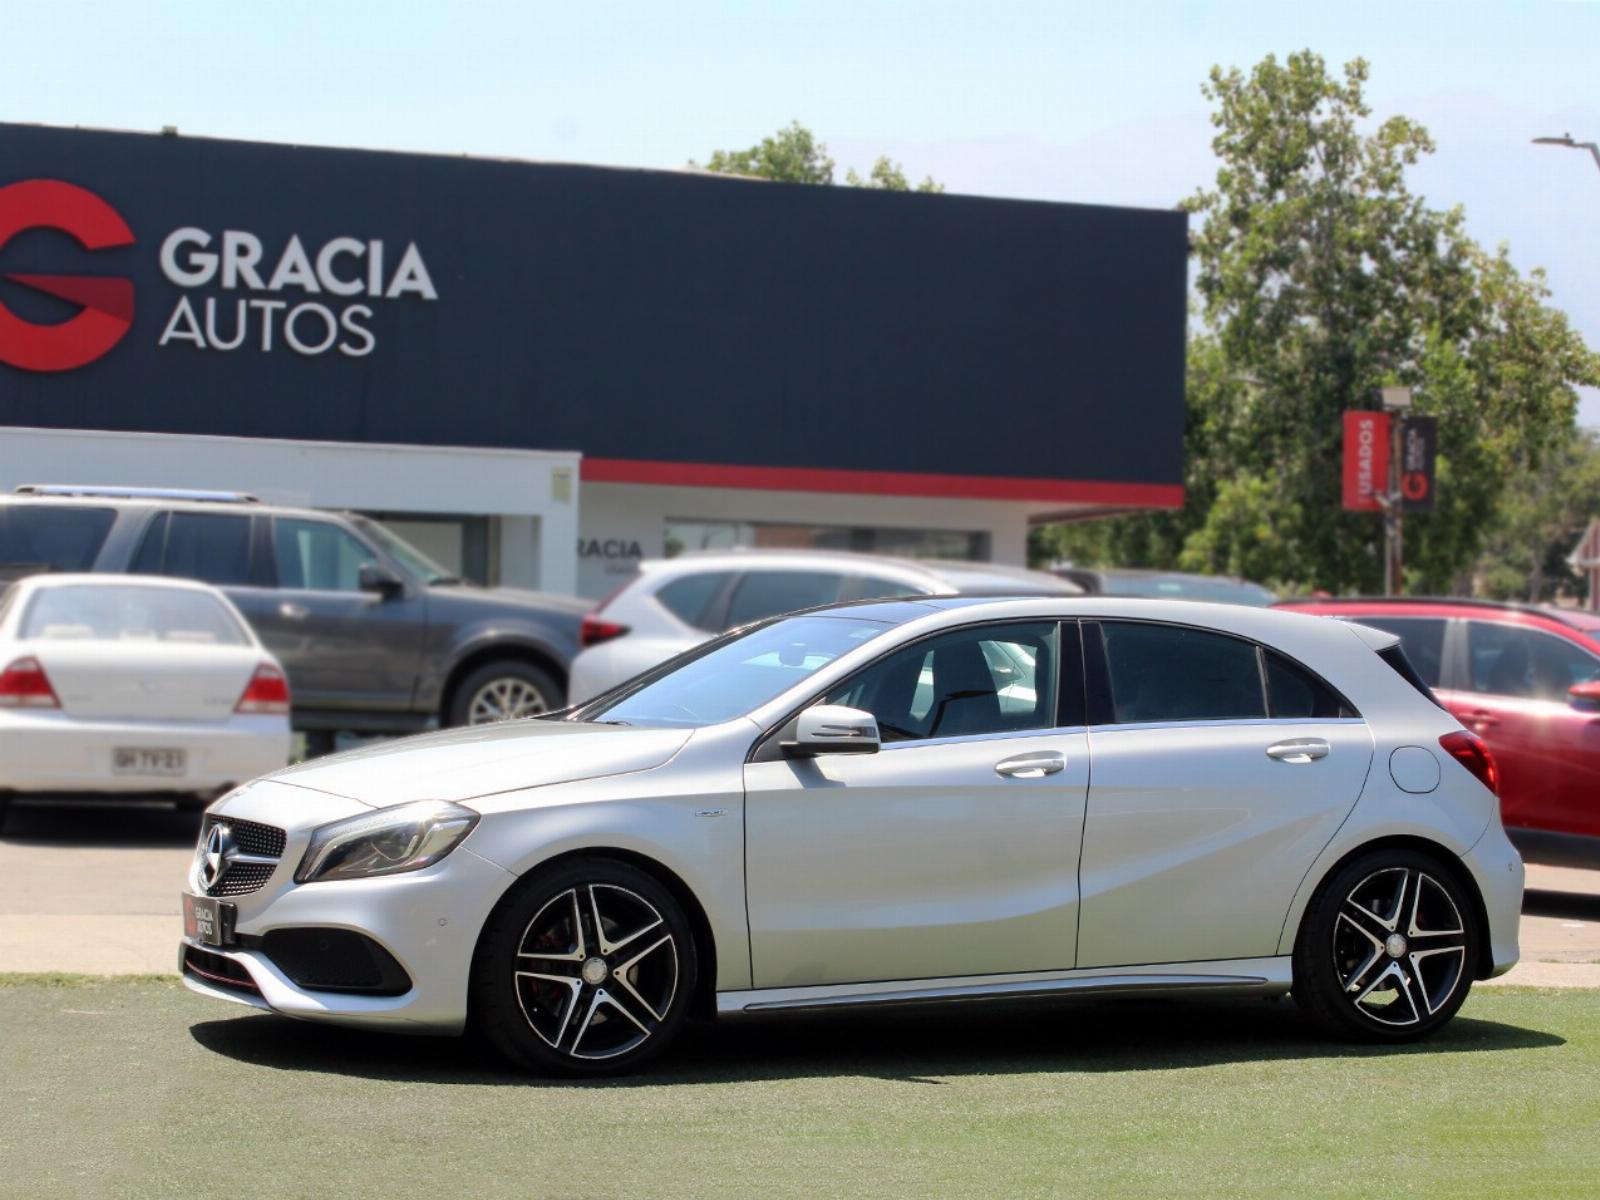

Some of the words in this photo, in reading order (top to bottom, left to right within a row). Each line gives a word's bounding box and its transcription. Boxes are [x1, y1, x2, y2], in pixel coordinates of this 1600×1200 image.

[159, 226, 438, 300] GRACIA
[158, 295, 376, 356] AUTOS
[1358, 419, 1374, 496] USADOS
